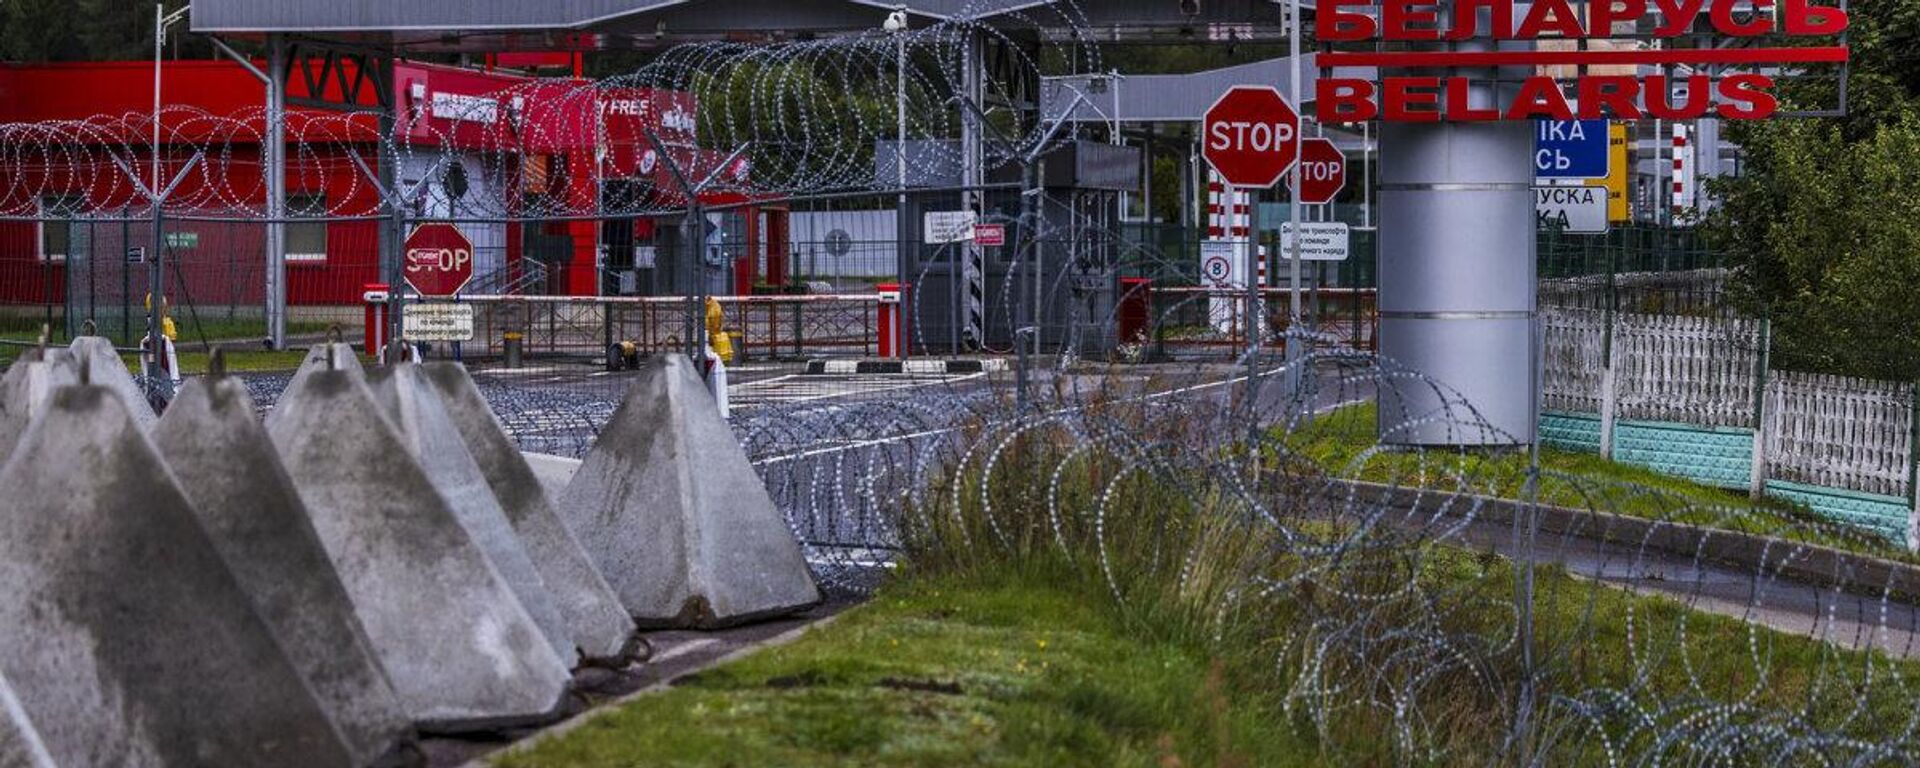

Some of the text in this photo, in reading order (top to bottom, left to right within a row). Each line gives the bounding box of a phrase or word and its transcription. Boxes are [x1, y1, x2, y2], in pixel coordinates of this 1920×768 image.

[1316, 0, 1849, 40] БЕЛАРУСЬ
[598, 99, 650, 116] Y FREE
[1316, 75, 1778, 122] BELARUS
[1210, 121, 1294, 152] STOP
[1540, 119, 1586, 141] ІКА
[1536, 148, 1571, 170] СЬ
[1302, 161, 1341, 181] TOP
[1536, 188, 1595, 204] УСКА
[1536, 209, 1570, 229] КА
[407, 248, 469, 272] SOP
[1212, 262, 1222, 276] 8
